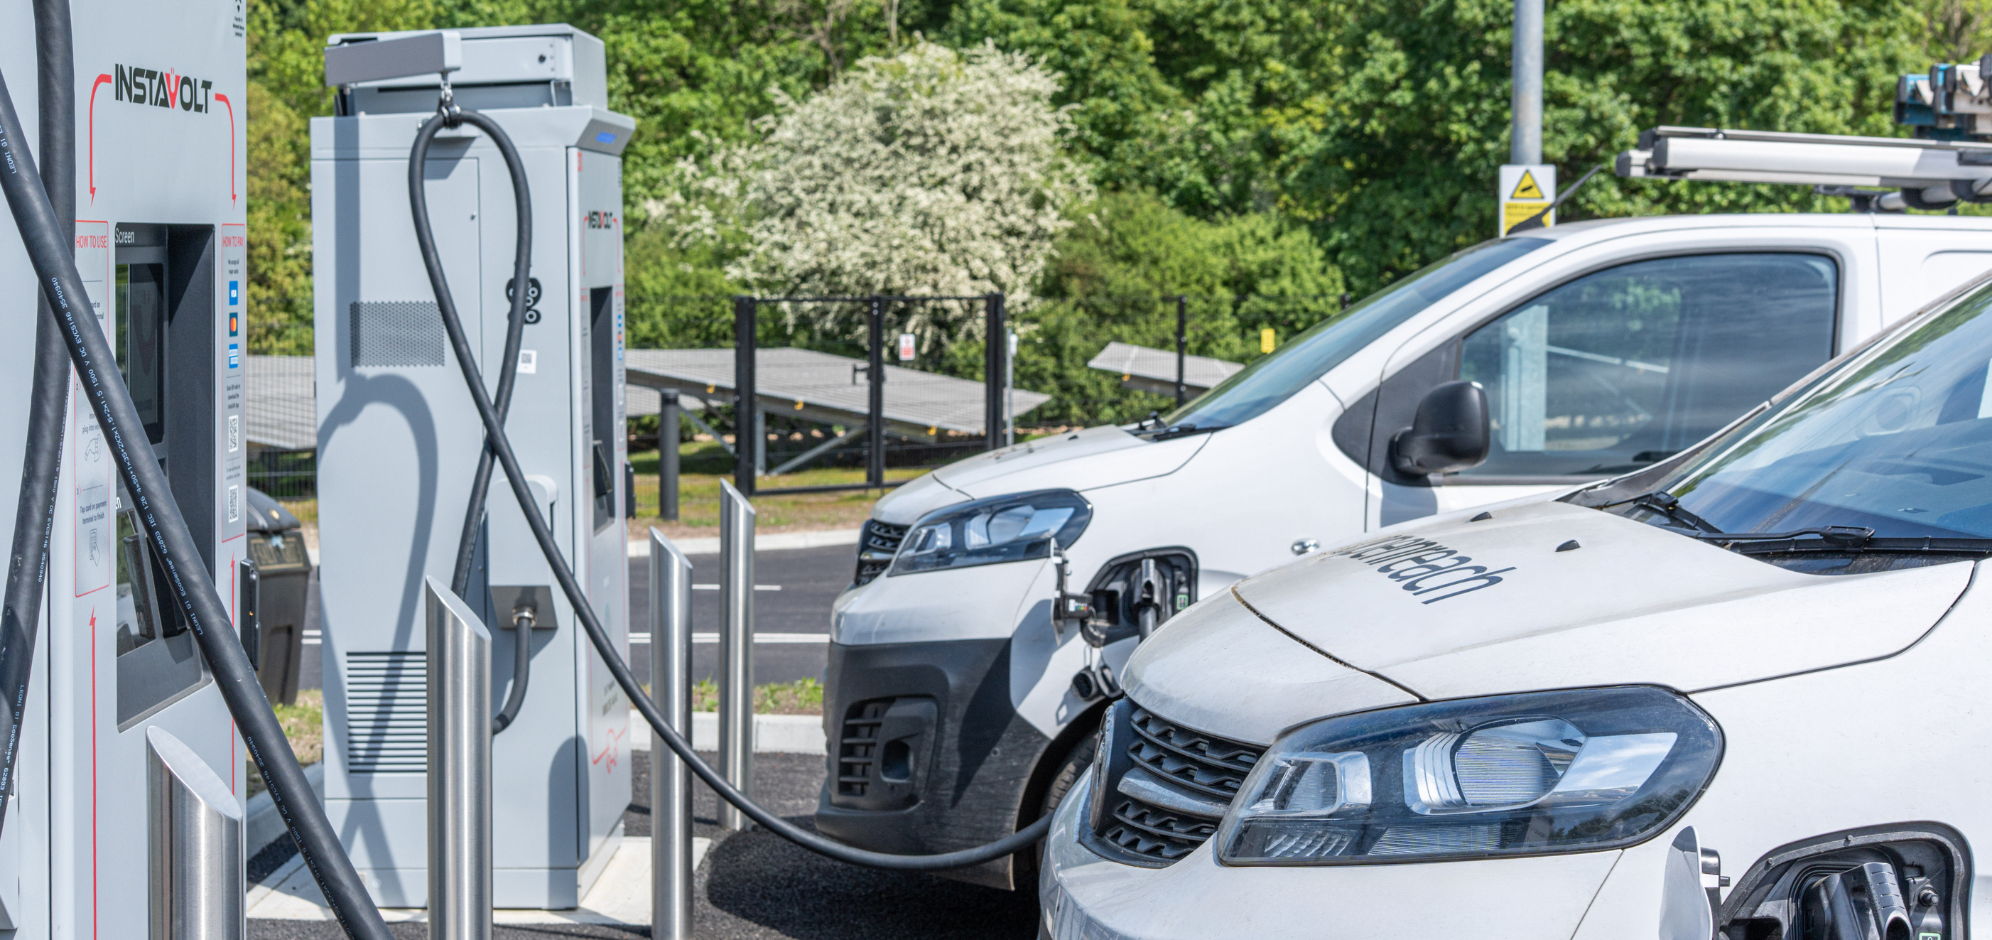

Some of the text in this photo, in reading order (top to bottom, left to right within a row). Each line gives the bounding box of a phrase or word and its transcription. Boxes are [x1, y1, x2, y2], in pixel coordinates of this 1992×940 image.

[115, 63, 212, 114] INSTAVOLT
[5, 151, 17, 174] LEONI
[75, 235, 107, 249] HOW TO USE
[115, 228, 135, 244] Screen
[79, 346, 88, 358] DC
